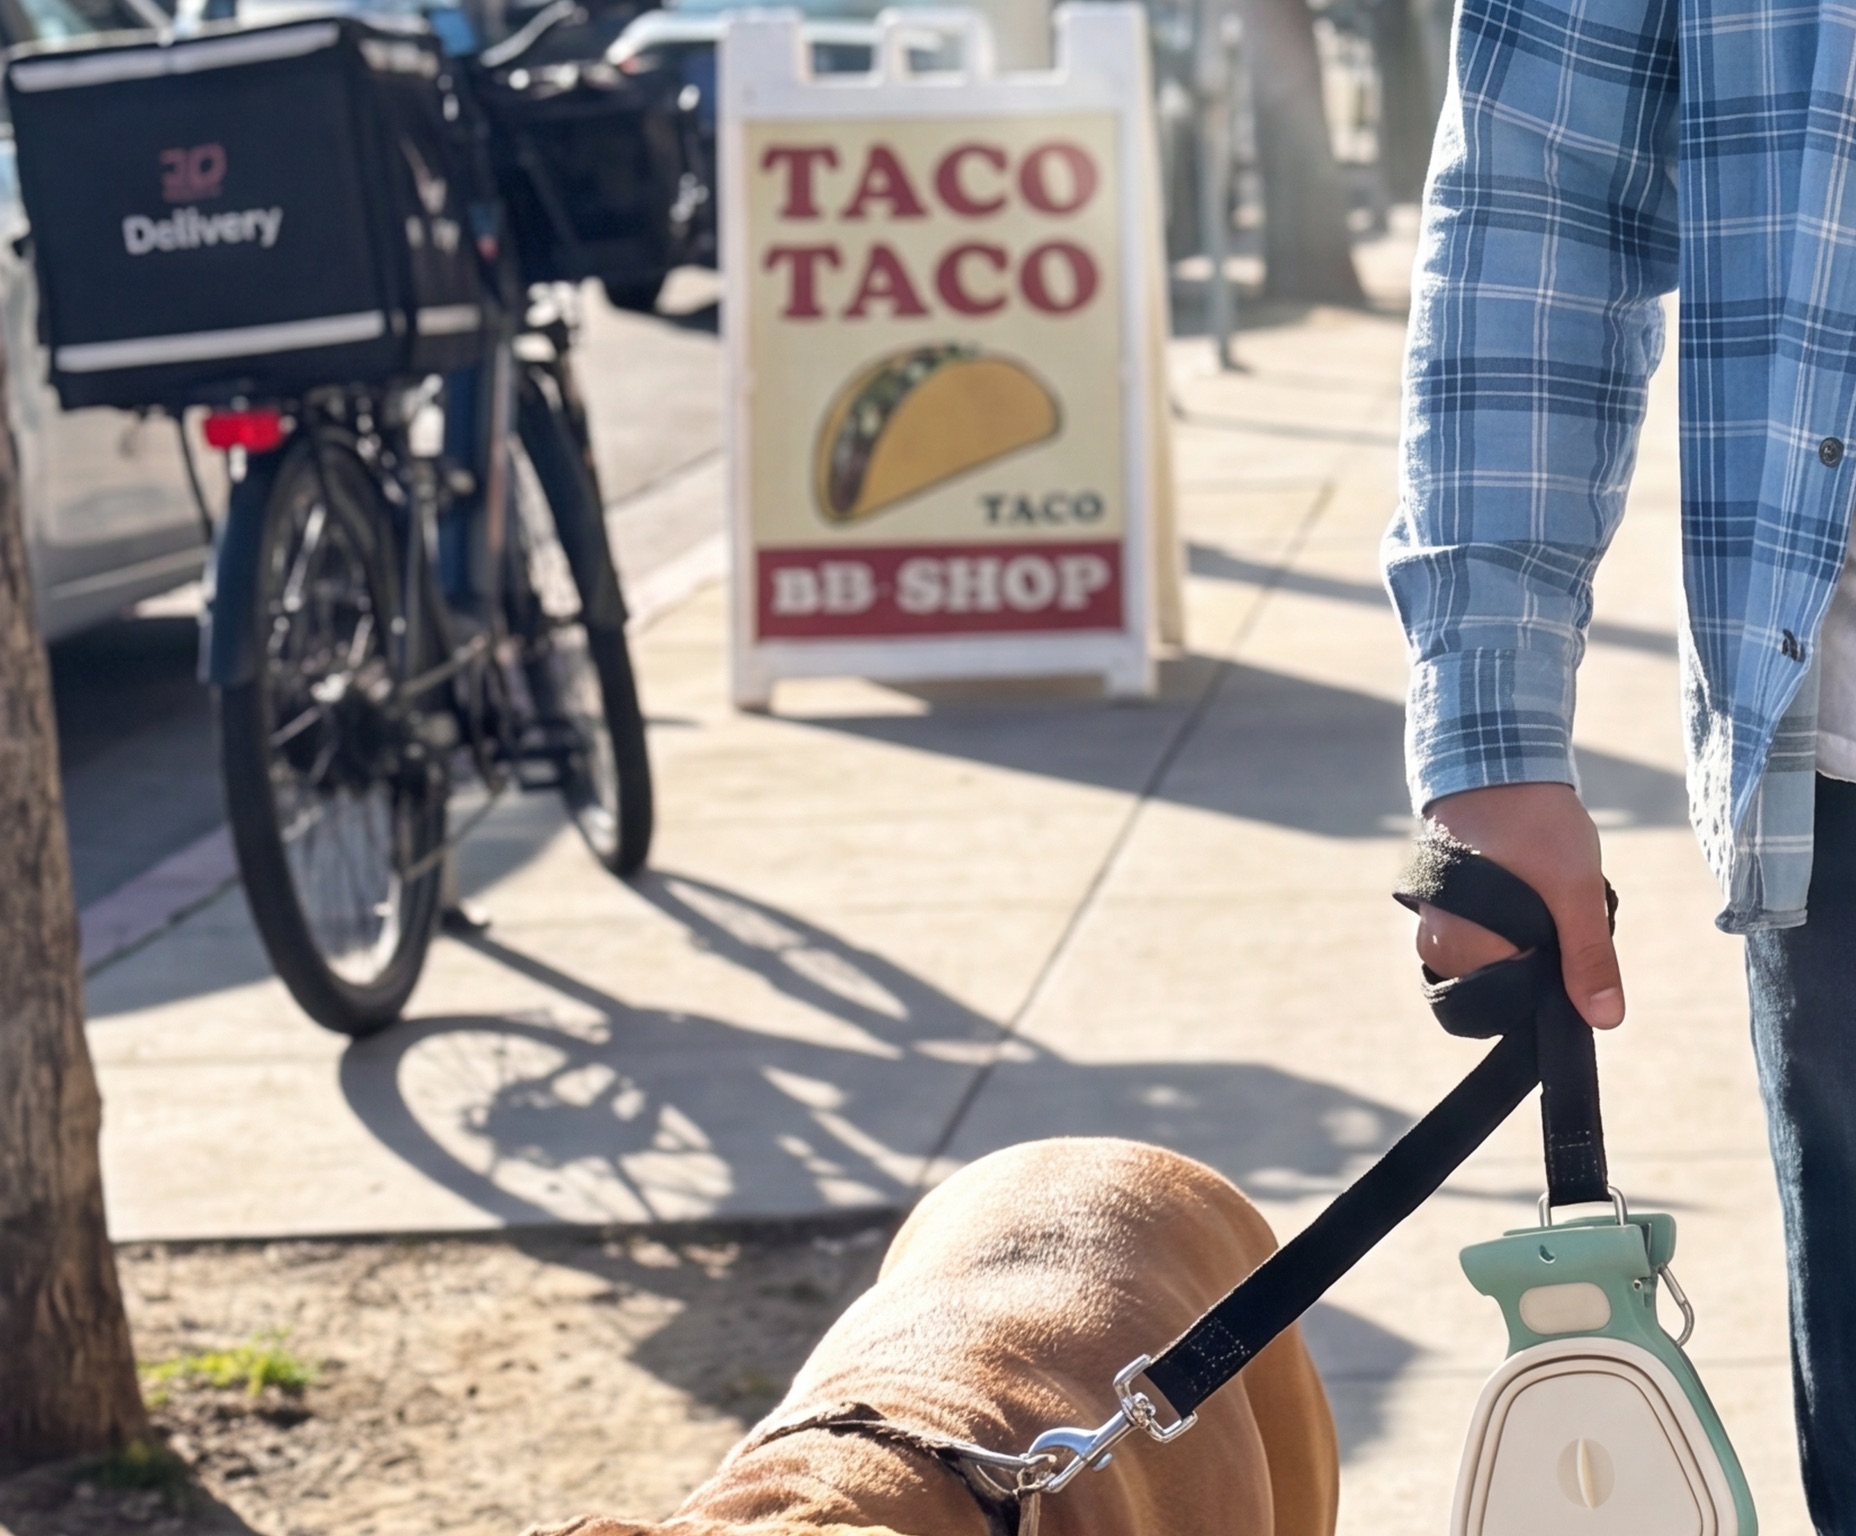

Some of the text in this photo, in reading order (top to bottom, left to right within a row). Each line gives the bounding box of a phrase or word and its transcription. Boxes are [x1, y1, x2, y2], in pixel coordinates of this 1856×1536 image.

[761, 138, 1099, 221] TACO
[122, 206, 283, 255] Delivery
[762, 239, 1101, 321] TACO
[980, 491, 1104, 525] TACO
[895, 554, 1110, 613] SHOP
